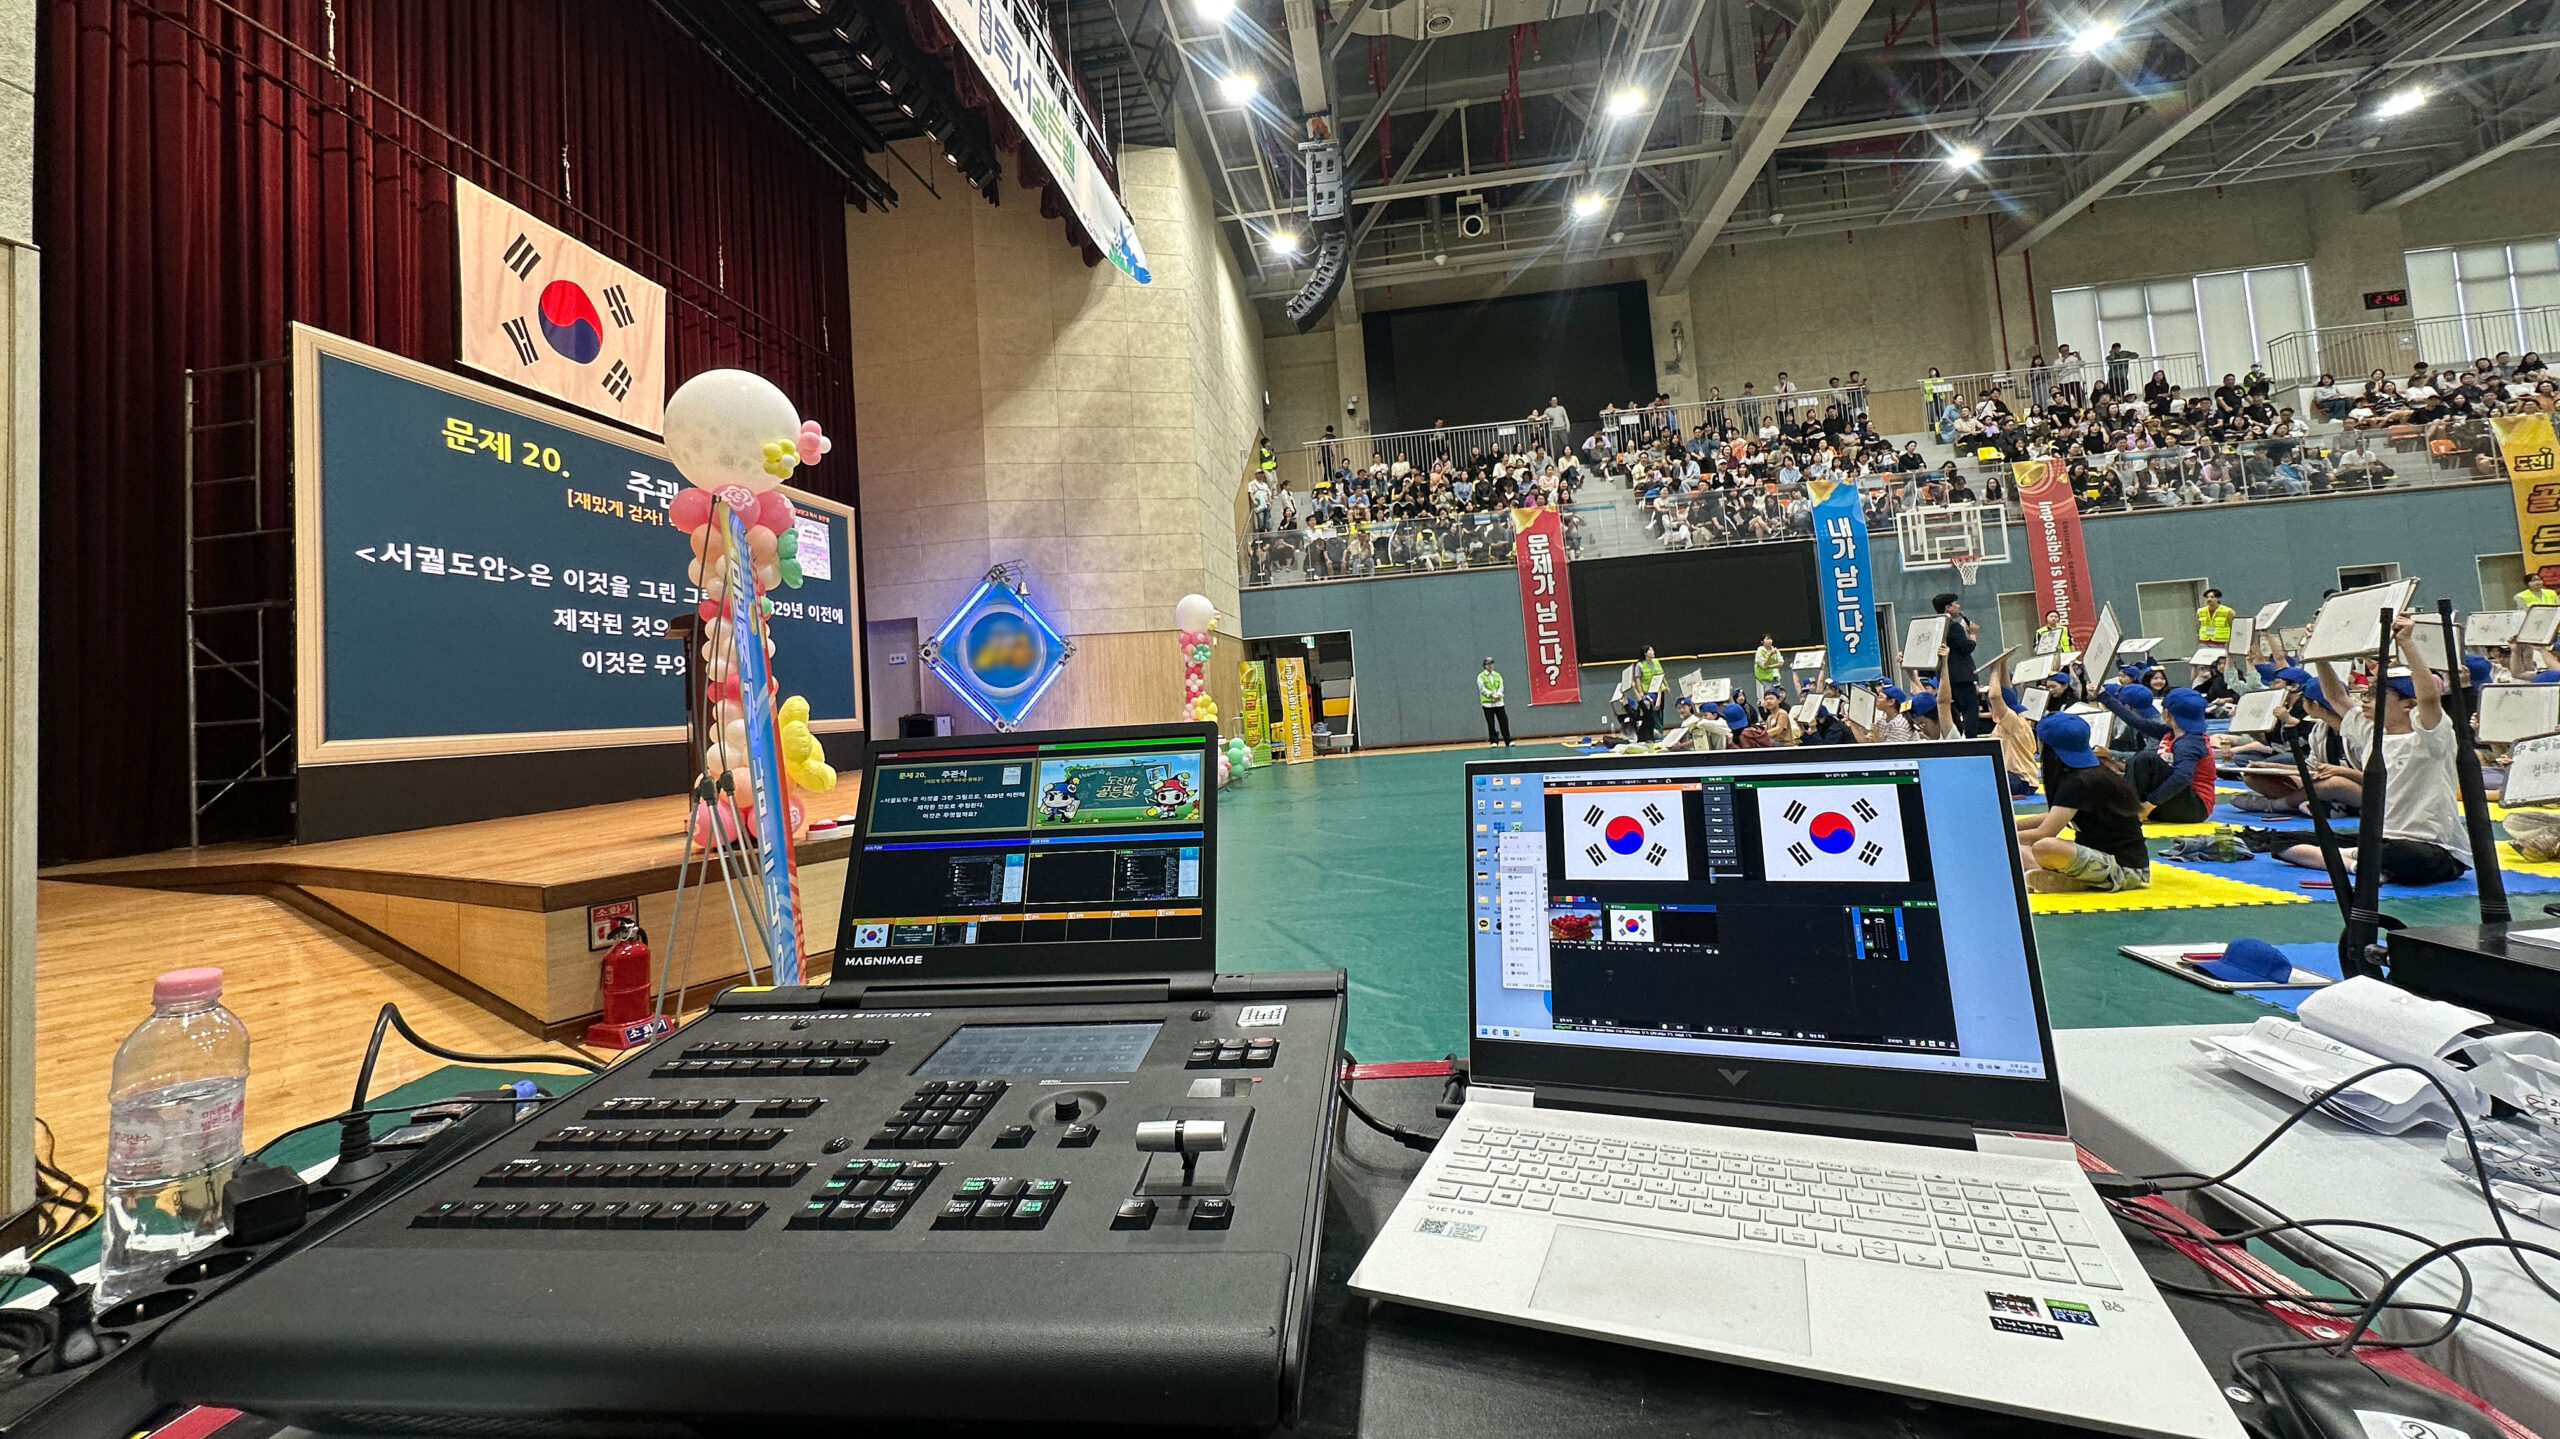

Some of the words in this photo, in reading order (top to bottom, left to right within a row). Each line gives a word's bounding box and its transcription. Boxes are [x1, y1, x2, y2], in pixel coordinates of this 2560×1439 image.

[441, 417, 513, 464] 문제
[521, 441, 571, 478] 20.
[2514, 449, 2554, 472] 도전!
[567, 487, 625, 519] [재밌게
[628, 502, 664, 530] 걷자!
[1827, 517, 1856, 560] 내가
[2038, 501, 2063, 563] Impossible
[1527, 533, 1556, 596] 문제가
[2050, 566, 2066, 577] is
[355, 540, 553, 589] <서궐도안>은
[563, 569, 631, 600] 이것을
[637, 579, 677, 604] 그린
[807, 604, 845, 625] 이전에
[553, 606, 624, 637] 제작된
[1834, 566, 1866, 655] 남느냐?
[1534, 601, 1561, 686] 남느냐?
[581, 650, 647, 676] 이것은
[1285, 664, 1298, 710] Impossible
[1291, 712, 1298, 720] is
[1291, 723, 1302, 757] Nothing
[596, 902, 633, 917] 소화기
[845, 956, 923, 966] MAGNIMAGE
[2527, 1164, 2546, 1178] 36
[1427, 1204, 1475, 1216] VICTUS
[1996, 1318, 2057, 1334] 144Hz
[2053, 1311, 2094, 1325] RTX
